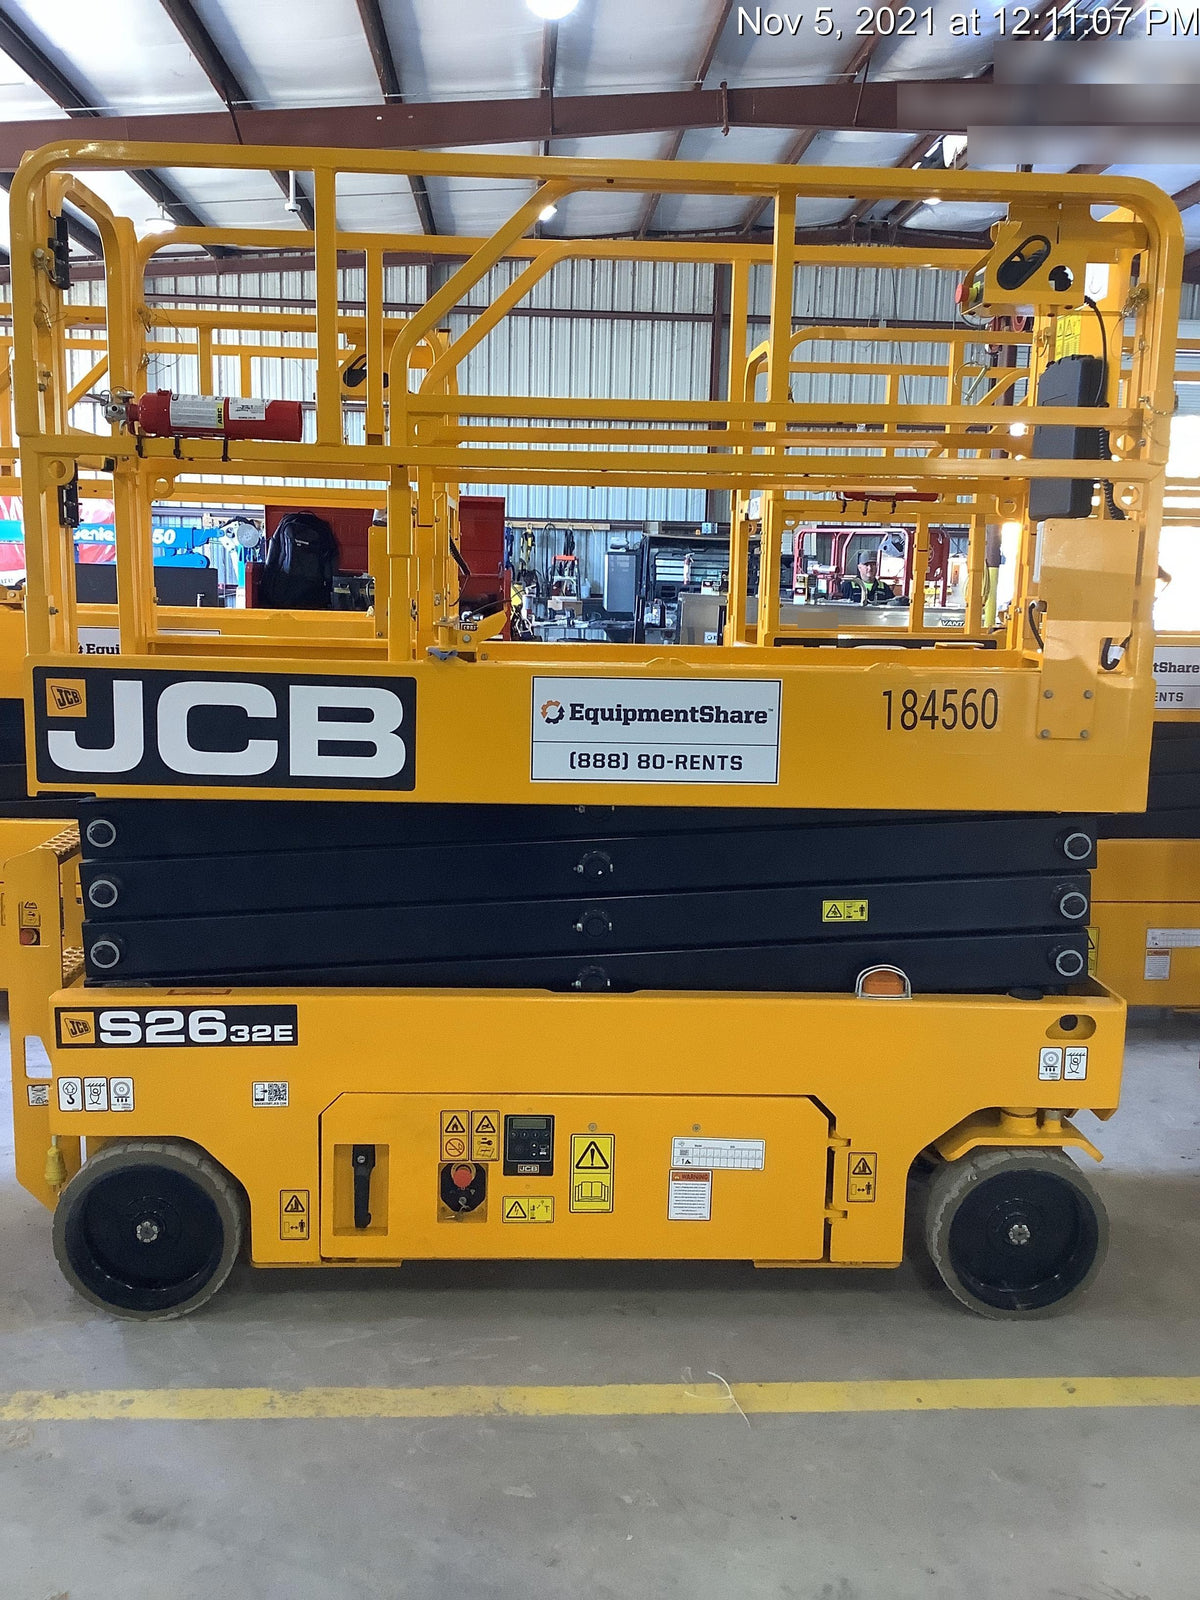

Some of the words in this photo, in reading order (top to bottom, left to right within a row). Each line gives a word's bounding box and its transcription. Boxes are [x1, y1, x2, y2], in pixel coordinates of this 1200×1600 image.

[56, 689, 80, 707] JCB
[882, 687, 999, 731] 184560
[47, 679, 406, 779] JCB
[570, 751, 629, 770] (888)
[637, 753, 743, 771] 80-RENTS
[69, 1020, 89, 1035] JCB
